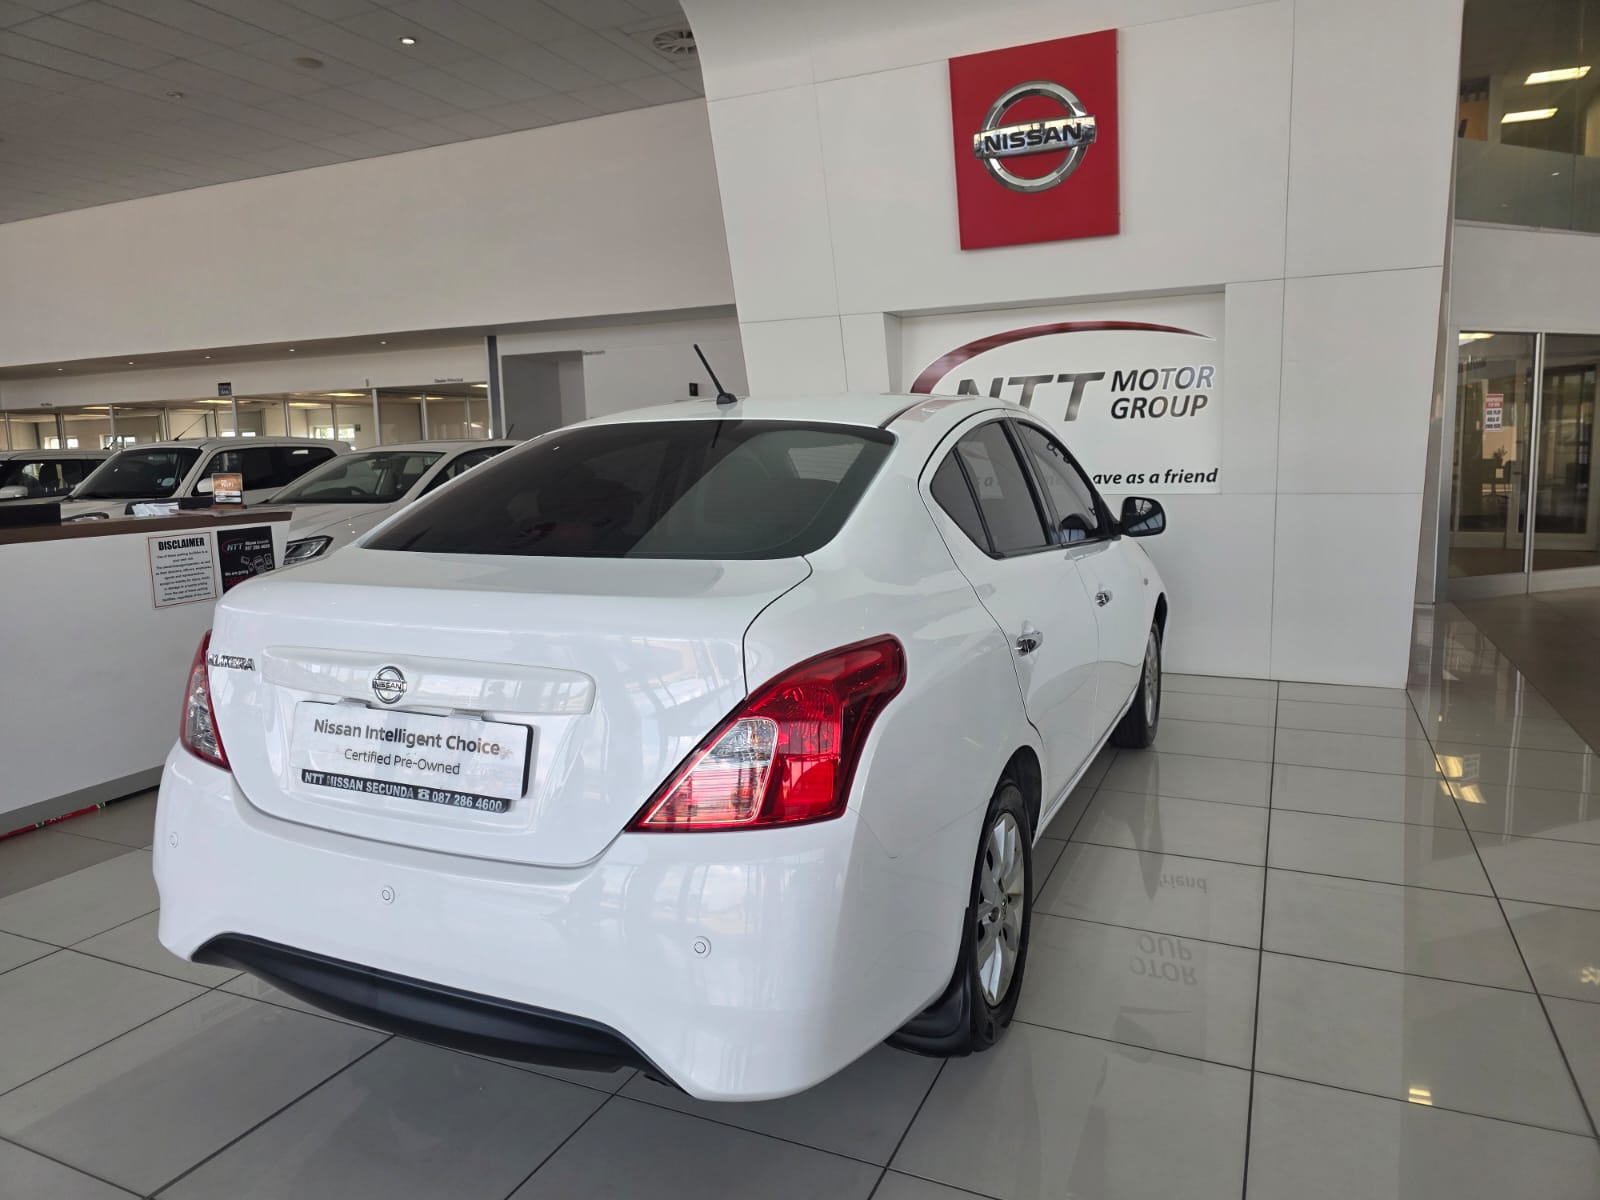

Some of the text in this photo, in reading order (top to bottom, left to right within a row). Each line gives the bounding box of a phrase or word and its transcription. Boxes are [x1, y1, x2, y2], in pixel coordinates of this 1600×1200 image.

[984, 122, 1082, 152] NISSAN
[1110, 366, 1215, 393] MOTOR
[1110, 394, 1209, 420] GROUP
[1126, 473, 1145, 485] as
[1148, 472, 1160, 484] a
[1162, 467, 1219, 485] friend
[158, 537, 205, 551] DISCLAIMER
[374, 681, 402, 690] NISSAN
[313, 718, 501, 756] Nissan Intelligent Choice
[344, 748, 461, 775] Certified Pre-Owned
[304, 772, 502, 812] NTT NISSAN SECUNDA 087 286 4600
